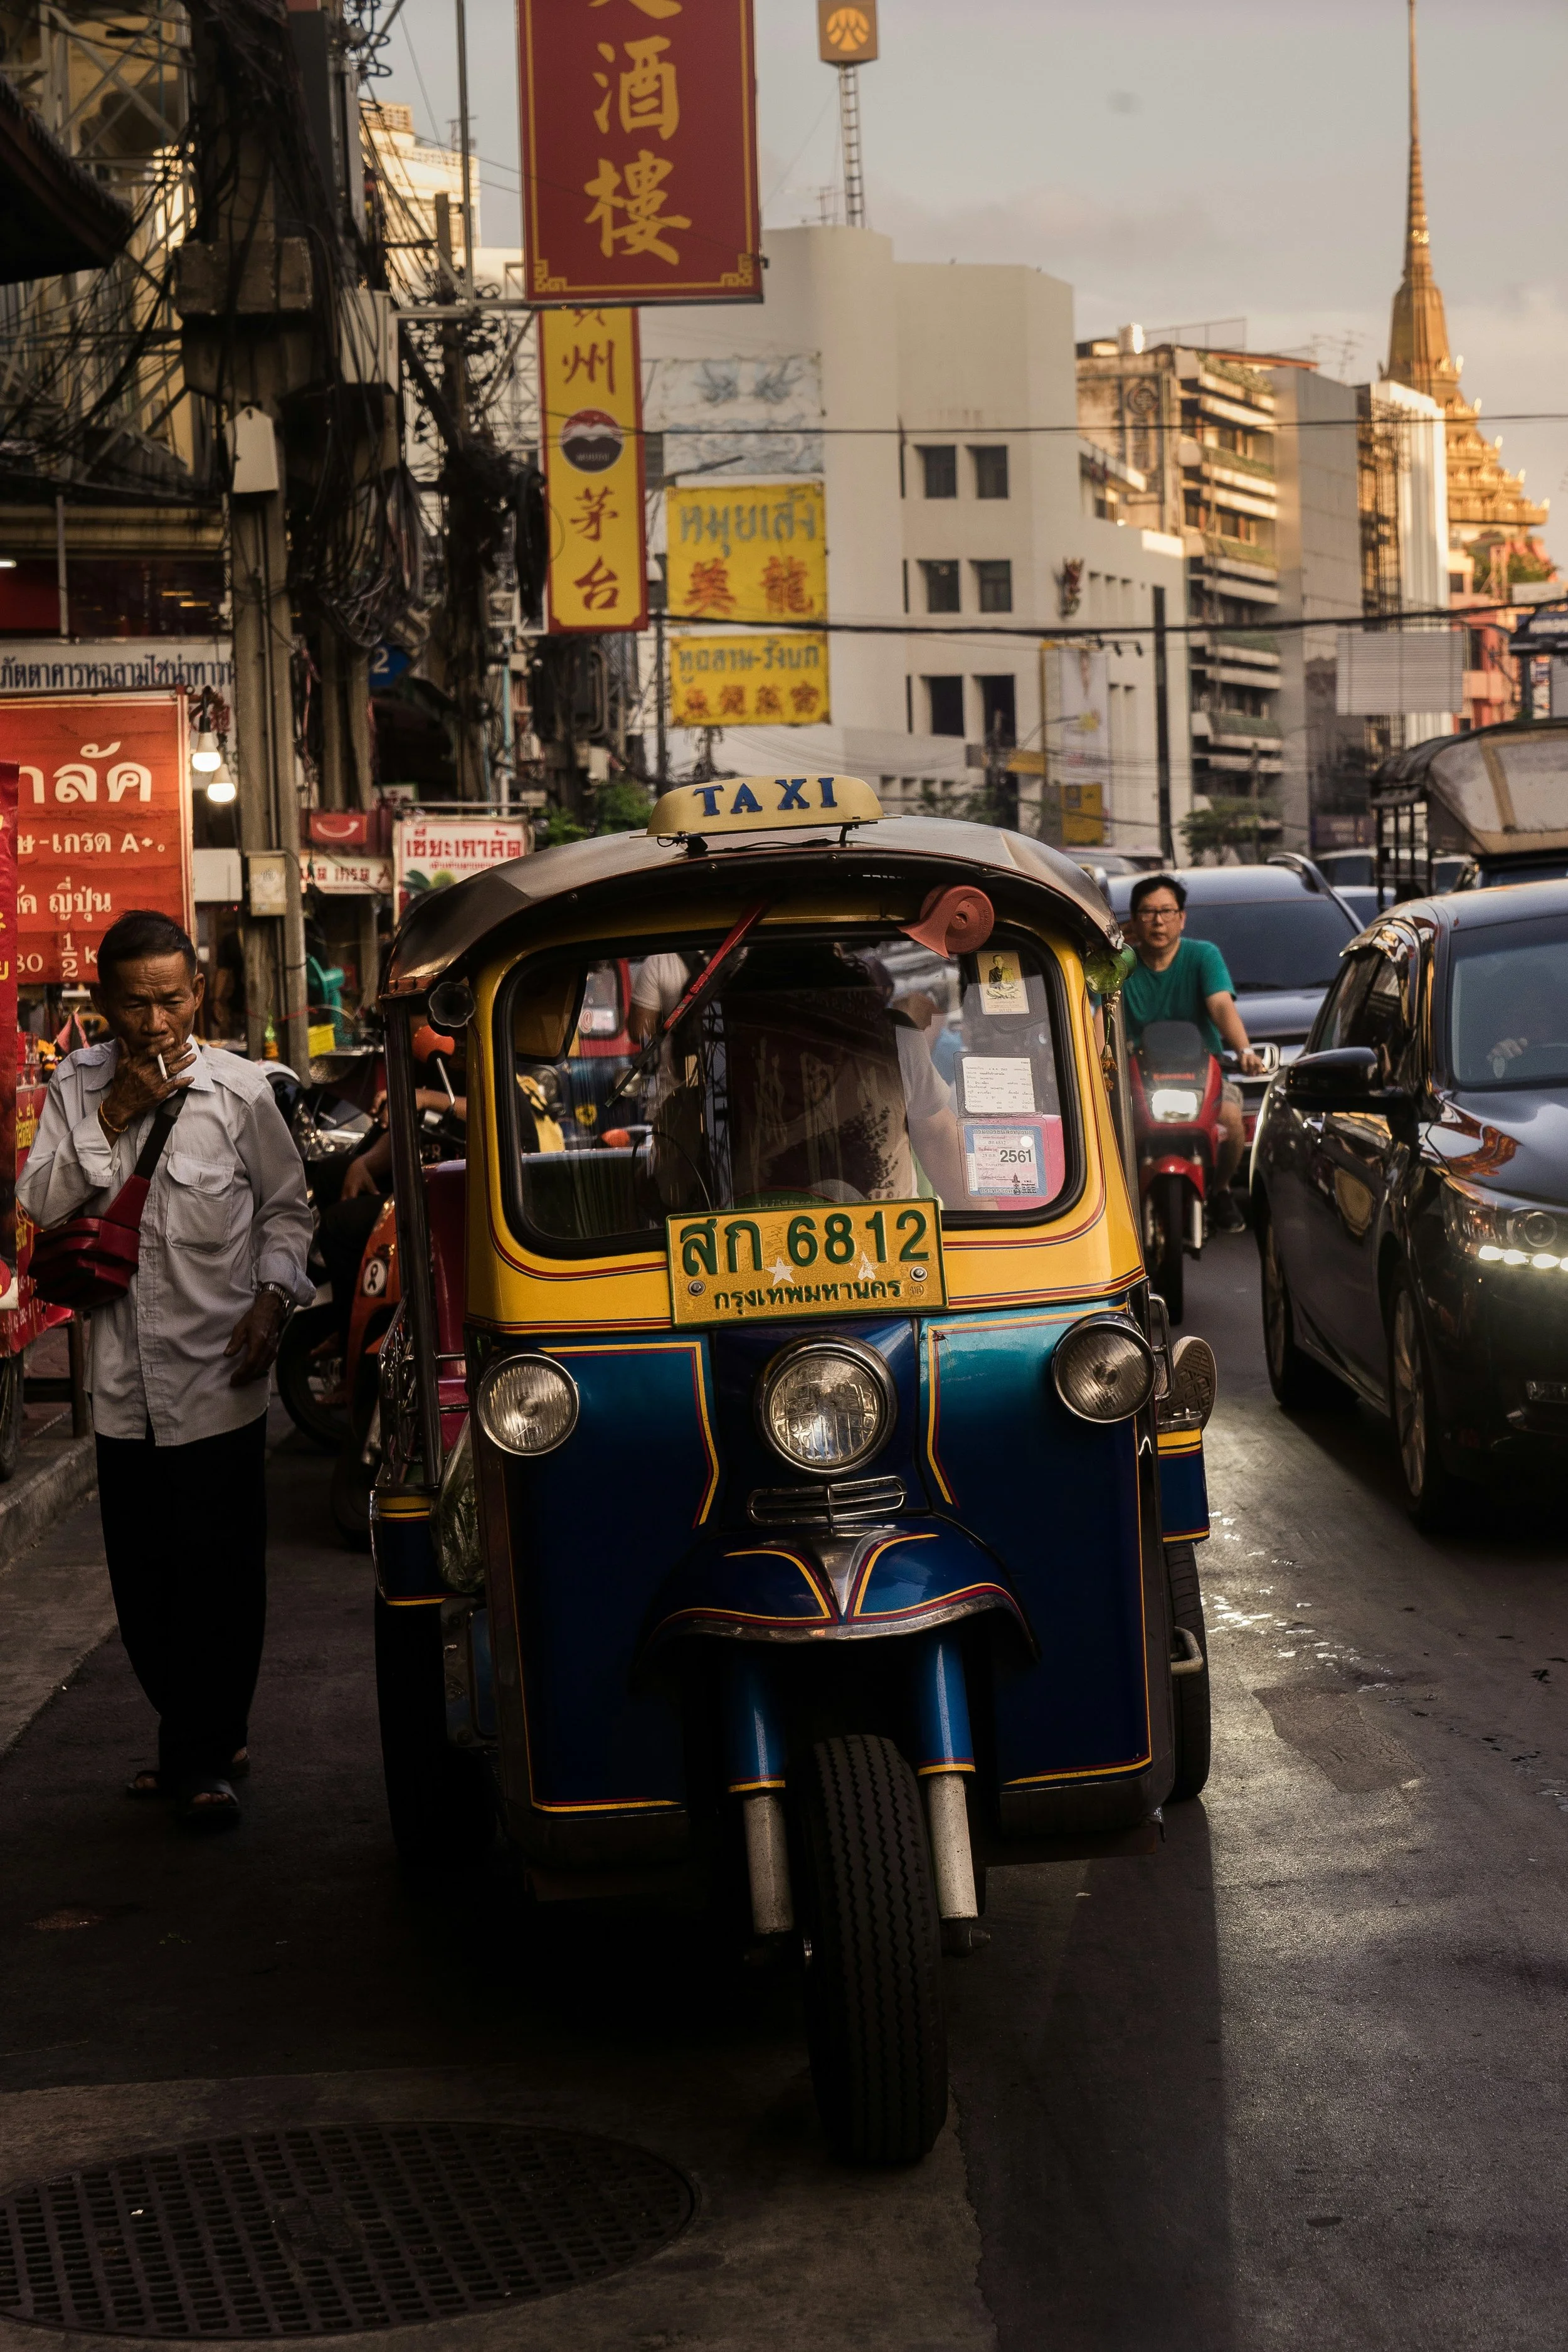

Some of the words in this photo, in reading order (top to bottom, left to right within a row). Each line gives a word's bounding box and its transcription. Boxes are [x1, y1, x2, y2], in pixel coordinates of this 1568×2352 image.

[694, 778, 838, 816] TAXI
[1000, 1149, 1032, 1163] 2561
[680, 1218, 763, 1276] สก
[788, 1209, 930, 1266] 6812
[714, 1280, 902, 1315] กรุงเทพมหานคร
